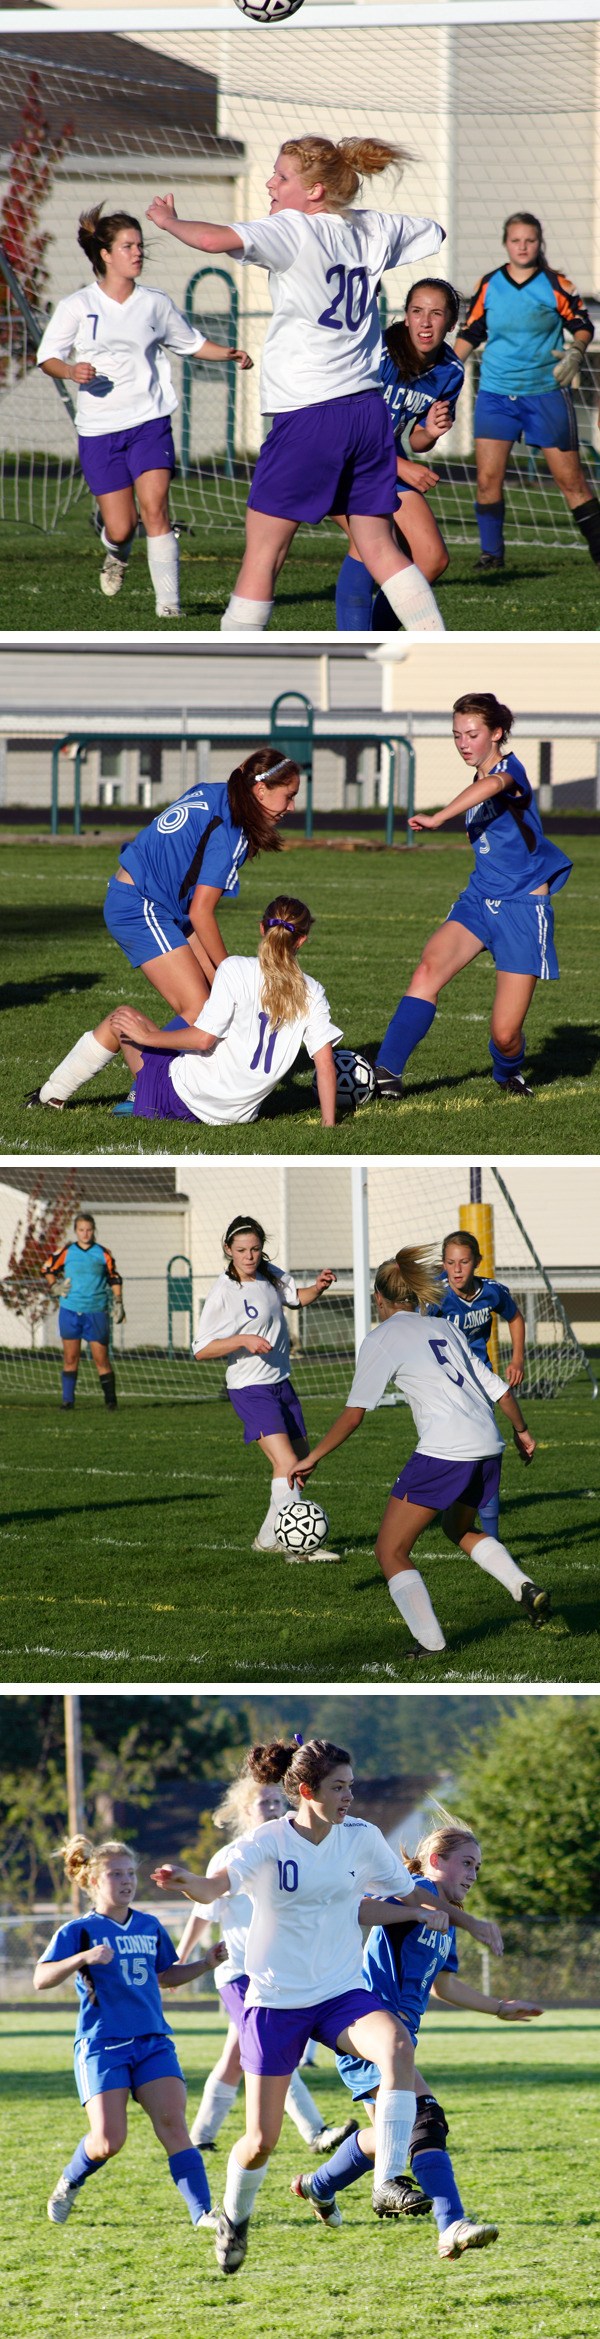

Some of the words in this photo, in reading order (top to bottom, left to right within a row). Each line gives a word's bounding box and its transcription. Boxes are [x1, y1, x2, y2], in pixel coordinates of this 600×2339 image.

[317, 263, 369, 332] 20
[86, 313, 99, 341] 7
[250, 1011, 279, 1075] 11
[243, 1298, 259, 1320] 6
[428, 1338, 465, 1388] 5
[277, 1859, 299, 1893] 10
[119, 1957, 149, 1986] 15
